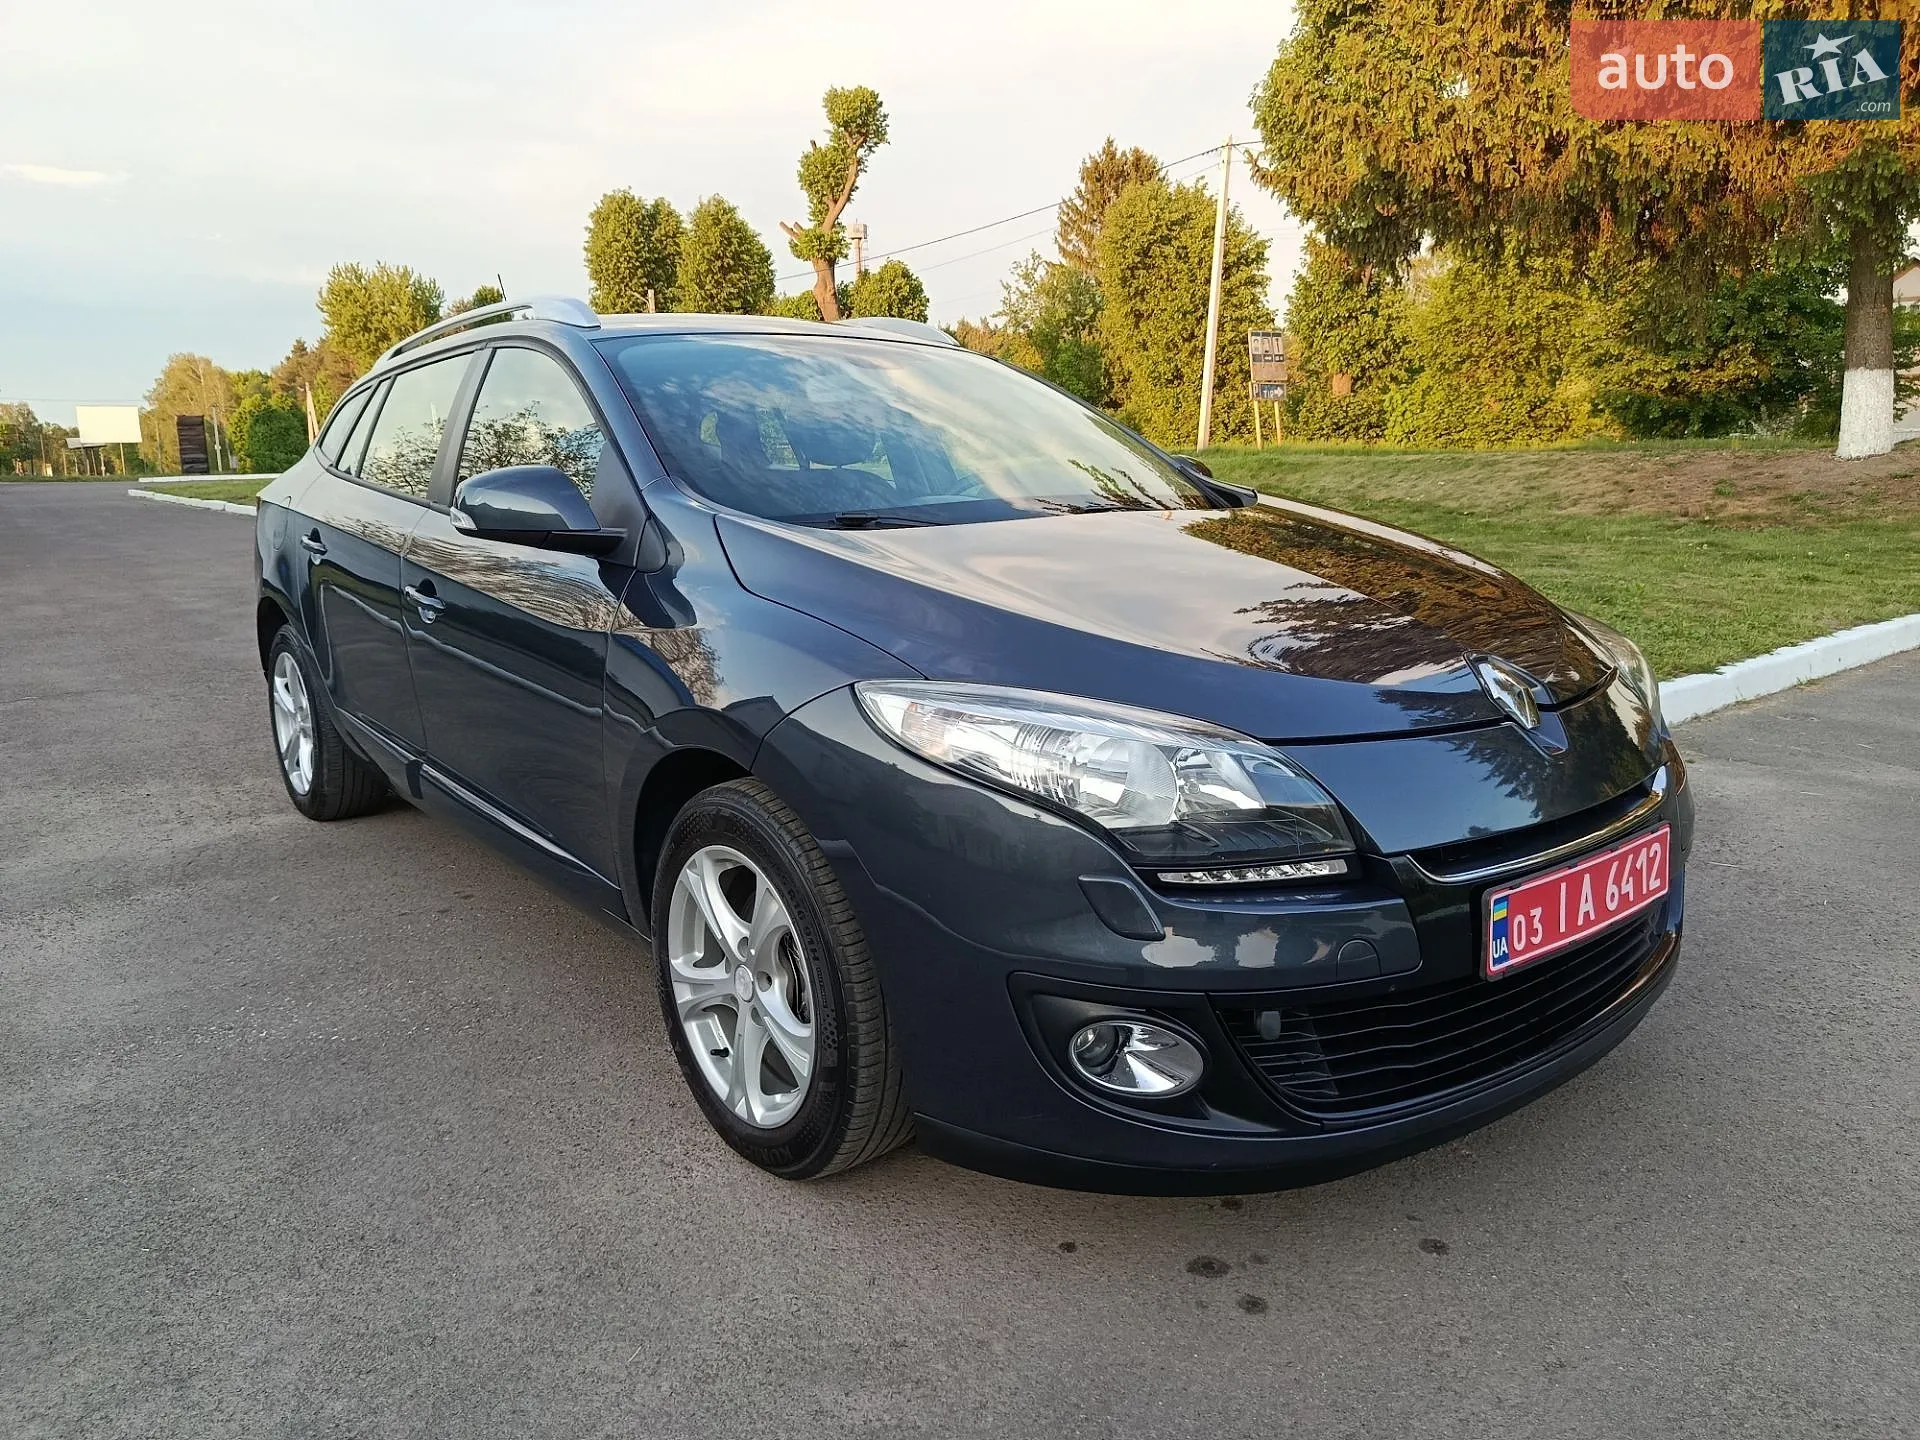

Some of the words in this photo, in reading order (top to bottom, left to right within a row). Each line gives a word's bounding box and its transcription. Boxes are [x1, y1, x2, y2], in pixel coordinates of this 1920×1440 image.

[1513, 906, 1543, 951] 03
[1559, 873, 1595, 933] IA
[1606, 842, 1662, 911] 6412
[1492, 937, 1508, 959] UA
